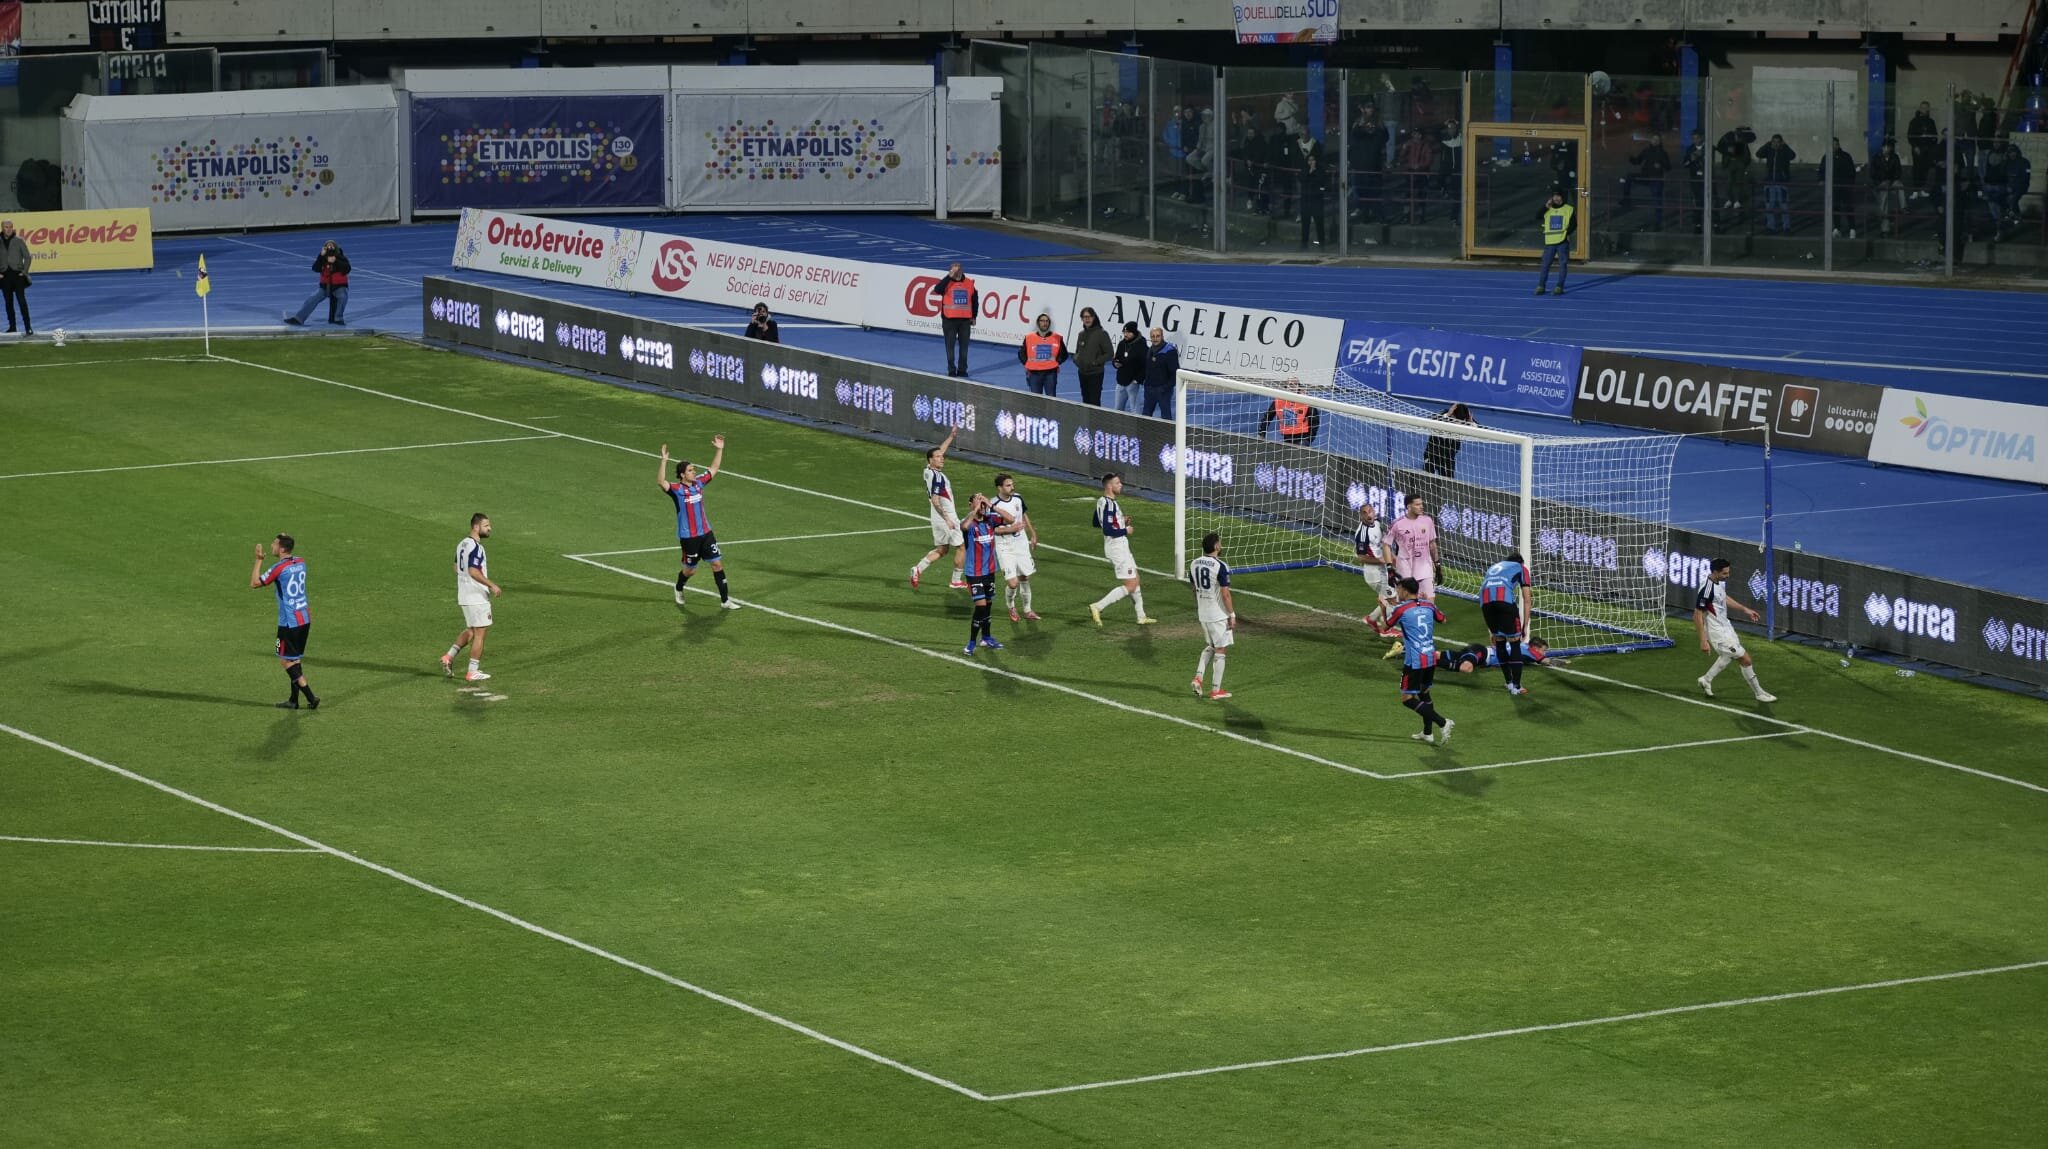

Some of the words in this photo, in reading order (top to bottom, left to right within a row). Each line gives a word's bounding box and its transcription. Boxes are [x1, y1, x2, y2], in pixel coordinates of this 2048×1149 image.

[1240, 34, 1276, 43] ATANIA
[479, 140, 590, 160] ETNAPOLIS
[614, 141, 631, 149] 130
[743, 138, 853, 157] ETNAPOLIS
[877, 138, 894, 147] 130
[187, 154, 291, 178] ETNAPOLIS
[313, 155, 329, 163] 130
[534, 163, 581, 171] DIVERTIMENTO
[487, 216, 604, 259] OrtoService
[499, 252, 531, 268] Servizi
[531, 258, 539, 270] &
[541, 257, 583, 278] Delivery
[651, 247, 698, 282] NSS
[706, 252, 736, 270] NEW
[736, 256, 804, 279] SPLENDOR
[805, 267, 860, 288] SERVICE
[726, 276, 770, 298] Società
[773, 284, 786, 299] di
[787, 288, 829, 306] servizi
[446, 299, 480, 330] errea
[510, 311, 544, 343] errea
[1107, 295, 1306, 348] ANGELICO
[571, 325, 607, 356] errea
[636, 337, 673, 370] errea
[706, 350, 744, 384] errea
[1186, 345, 1232, 365] BIELLA
[1239, 352, 1267, 370] DAL
[1270, 356, 1299, 373] 1959
[1407, 347, 1461, 379] CESIT
[1461, 353, 1508, 386] S.R.L
[1530, 358, 1562, 370] VENDITA
[779, 366, 818, 399] errea
[1516, 383, 1566, 399] RIPARAZIONE
[1521, 370, 1566, 385] ASSISTENZA
[852, 381, 893, 415] errea
[932, 396, 976, 431] errea
[1827, 404, 1877, 421] lollocaffe.it
[1015, 413, 1059, 449] errea
[1926, 424, 2035, 463] OPTIMA
[1094, 430, 1140, 466] errea
[1184, 448, 1233, 485] errea
[1276, 466, 1325, 503] errea
[1462, 507, 1513, 547] errea
[1563, 529, 1617, 571] errea
[287, 571, 306, 597] 68
[1195, 566, 1211, 590] 18
[1669, 552, 1711, 589] erre
[1777, 574, 1840, 618] errea
[1417, 614, 1429, 639] 5
[1893, 597, 1956, 643] errea
[2011, 622, 2048, 661] err
